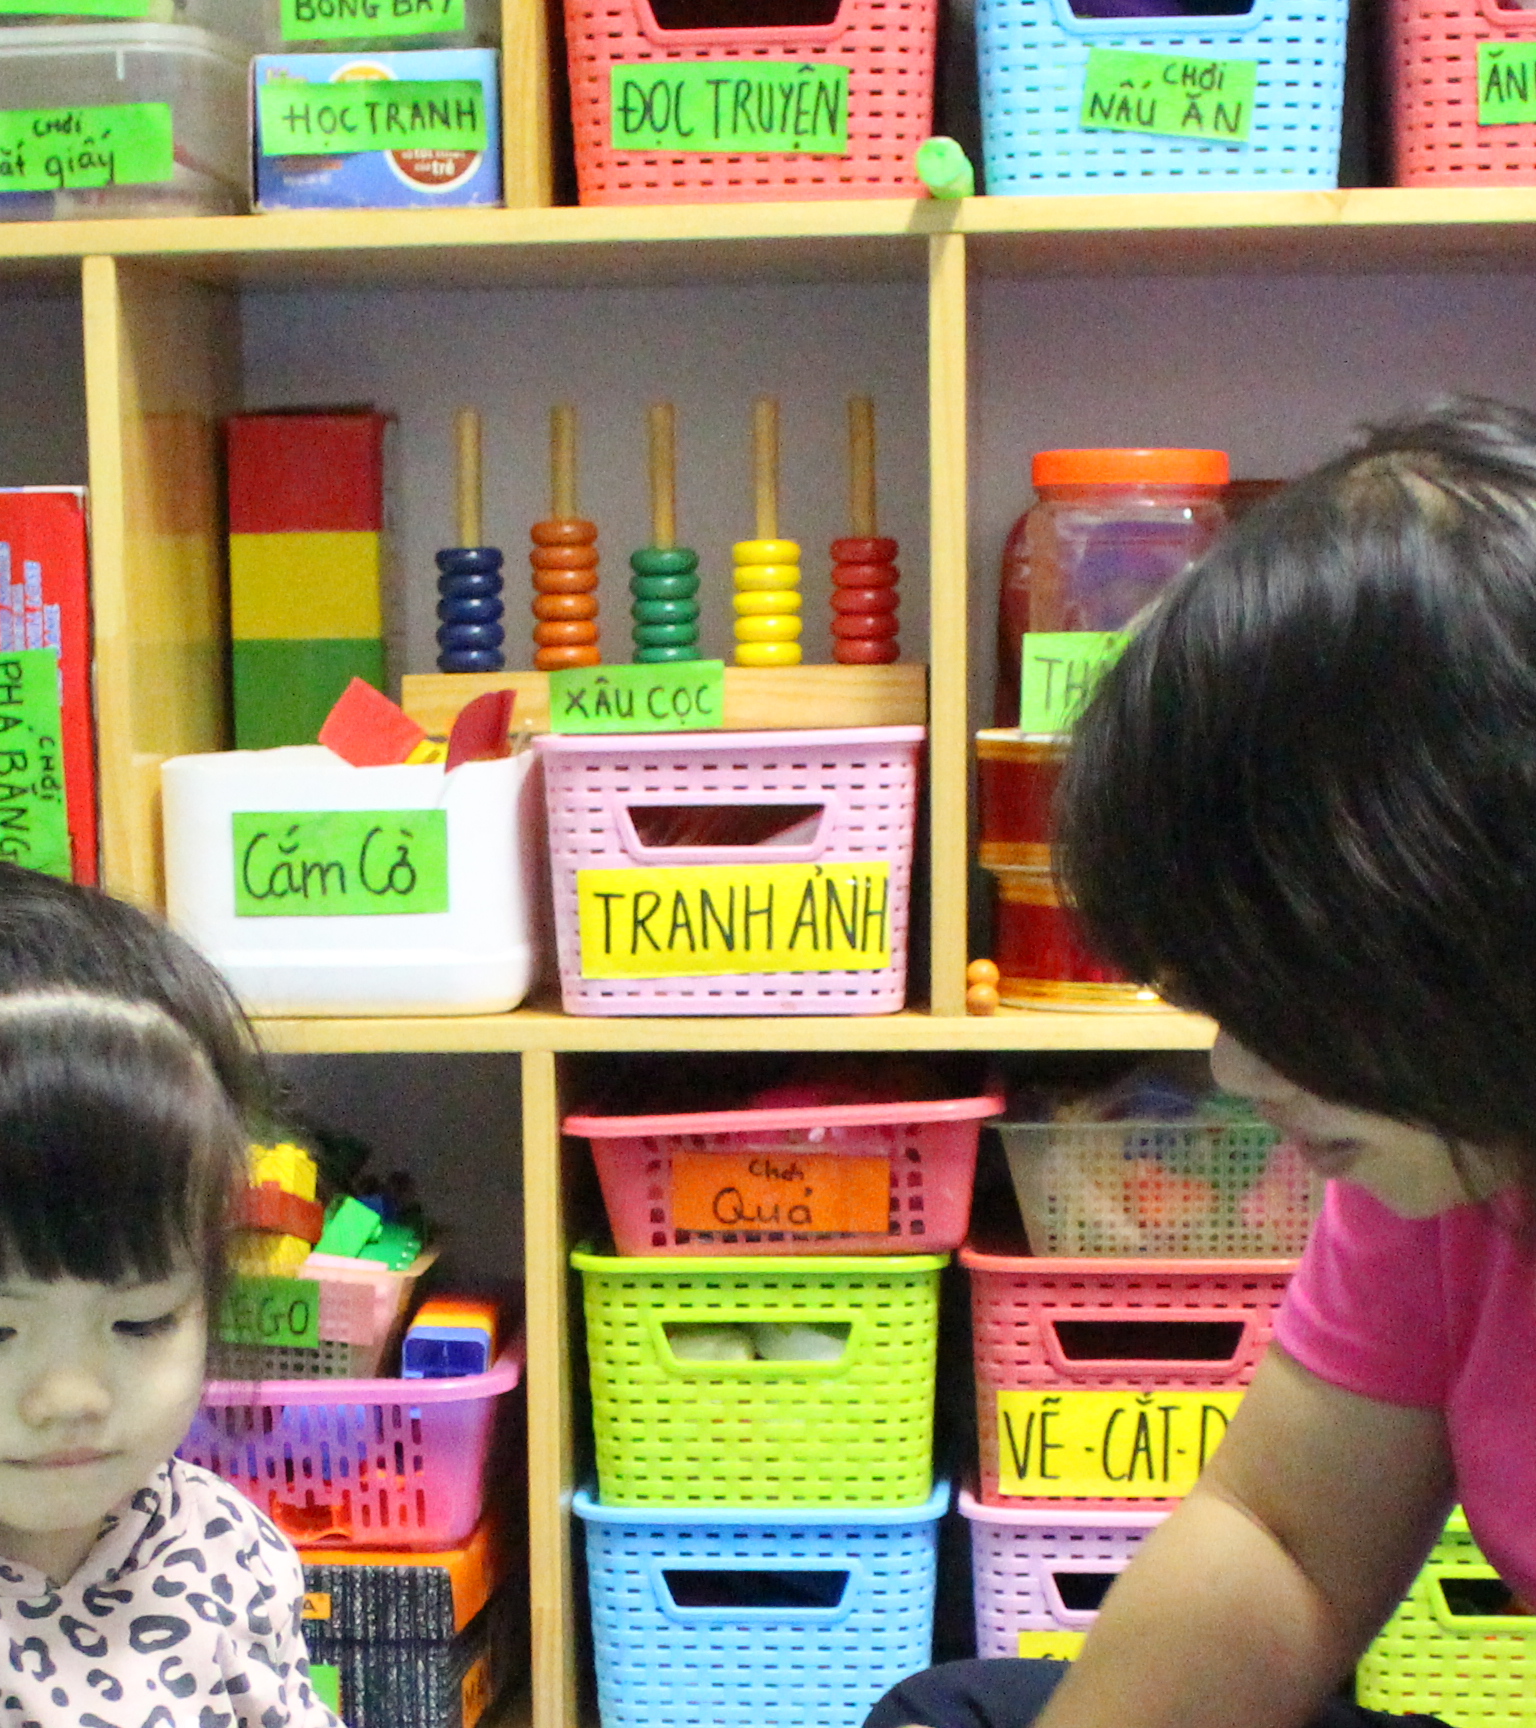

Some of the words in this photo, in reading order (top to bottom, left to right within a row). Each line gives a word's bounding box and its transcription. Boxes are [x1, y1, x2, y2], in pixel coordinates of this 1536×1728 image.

[364, 96, 477, 135] TRANH
[618, 78, 695, 146] ĐỌC
[705, 63, 842, 150] TRUYỆN
[1088, 79, 1157, 128] NẤU
[1180, 91, 1244, 134] ĂN
[45, 130, 115, 188] giấy
[565, 676, 634, 719] XÂU
[647, 683, 714, 726] CỌC
[243, 823, 348, 900] Cắm
[593, 883, 775, 955] TRANH
[788, 863, 890, 954] ẢNH
[1002, 1396, 1065, 1481] VẼ
